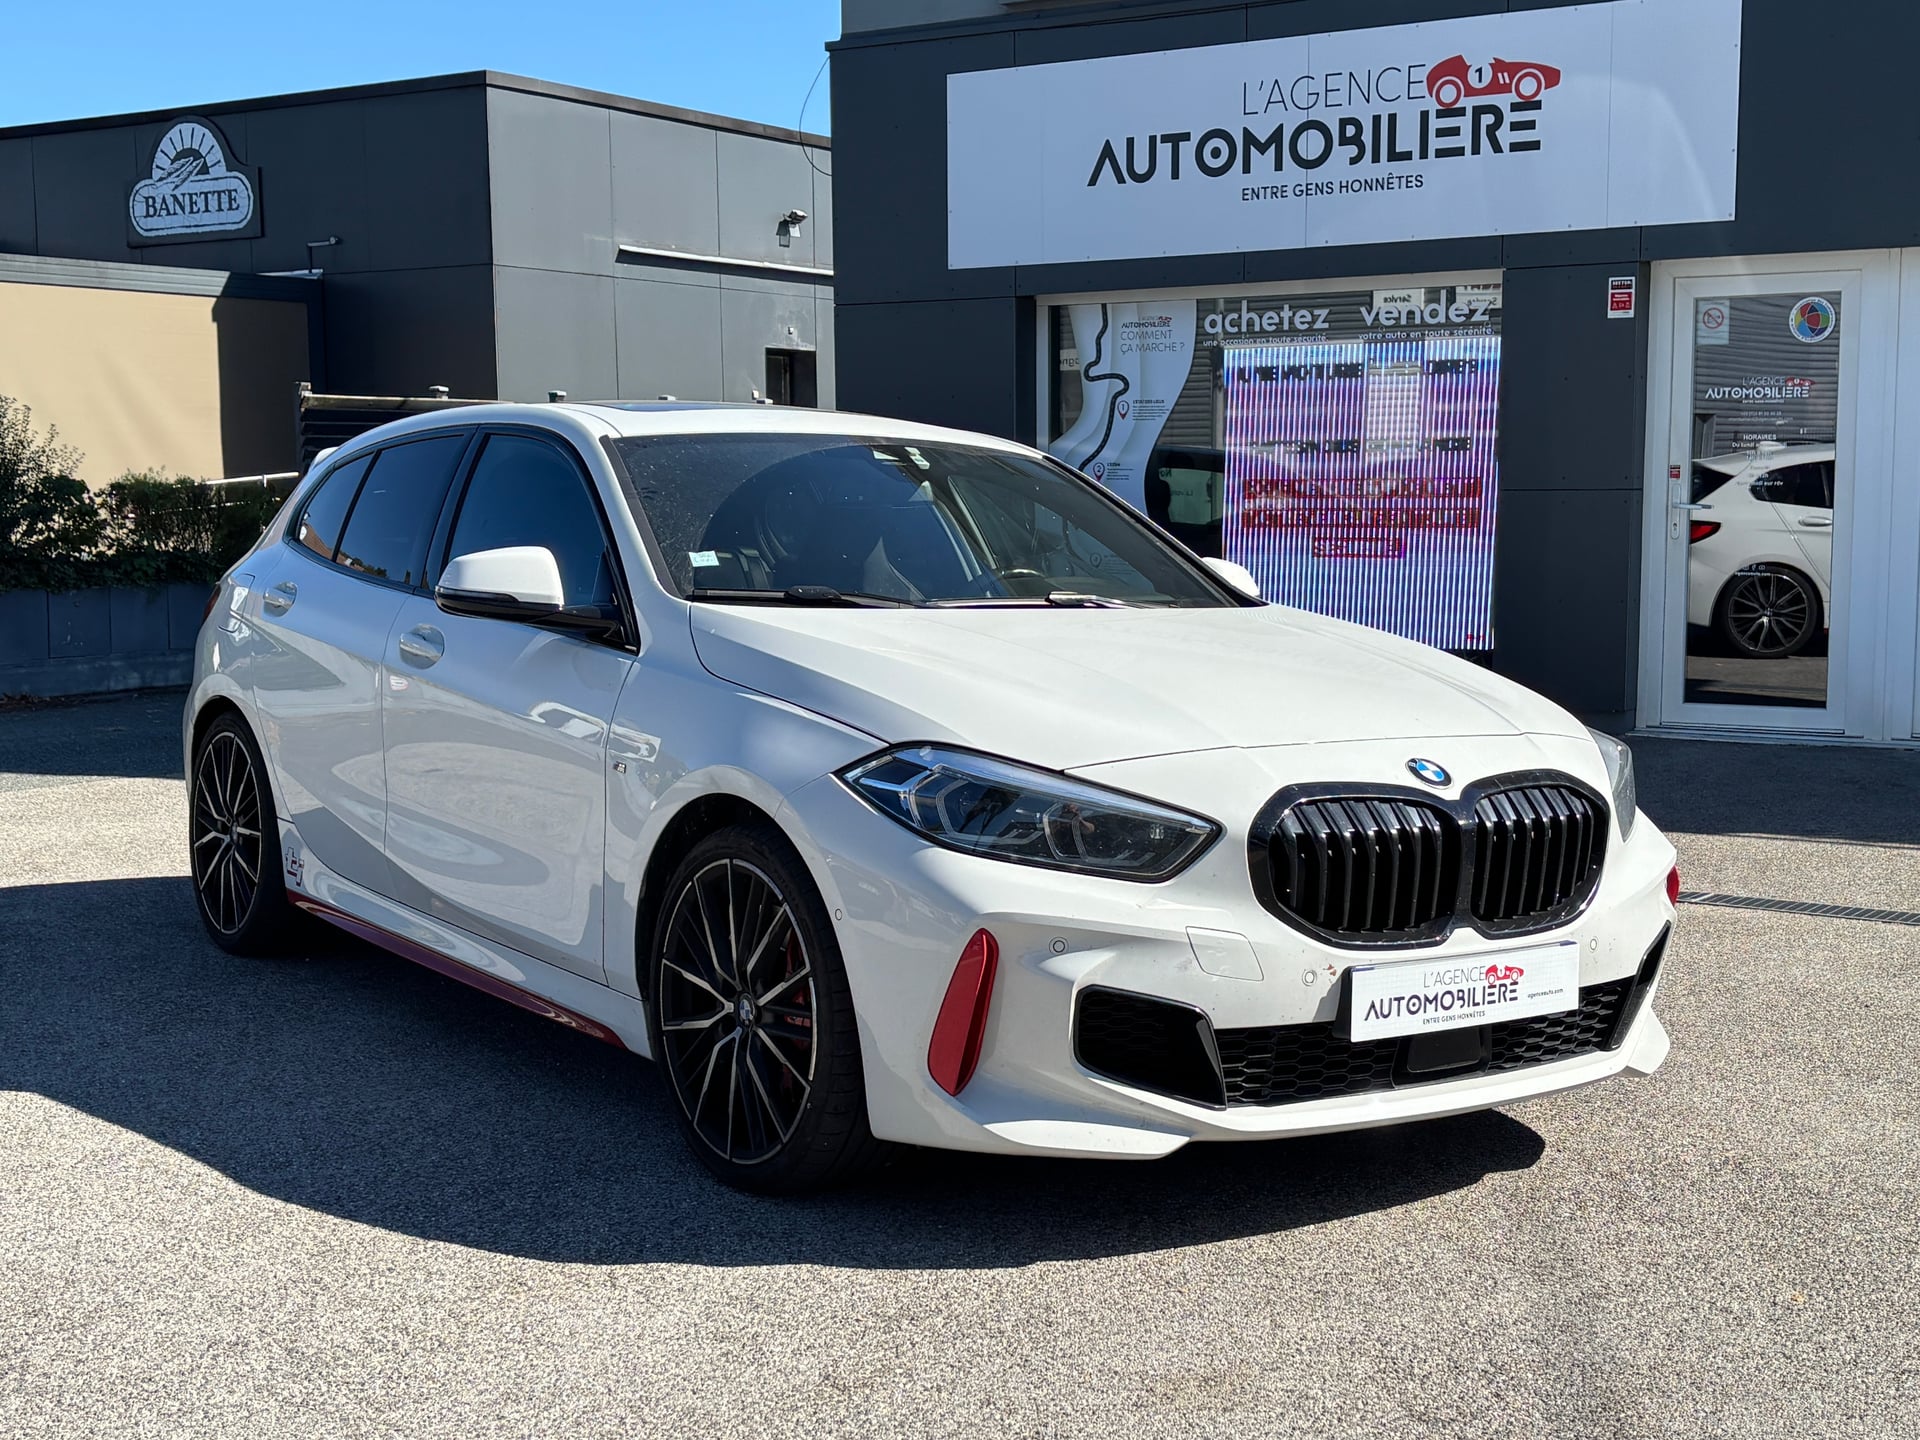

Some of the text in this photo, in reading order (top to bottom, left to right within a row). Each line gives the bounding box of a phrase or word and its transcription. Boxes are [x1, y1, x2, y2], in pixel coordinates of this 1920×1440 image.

[1243, 63, 1427, 116] L'AGENCE
[1241, 172, 1425, 201] ENTRE GENS HONNÊTES
[143, 188, 240, 219] BANETTE
[1203, 299, 1330, 334] achetez
[1359, 289, 1491, 327] vendez
[1120, 329, 1173, 341] COMMENT
[1203, 339, 1218, 347] une
[1220, 335, 1254, 346] occasion
[1269, 335, 1292, 344] toute
[1359, 331, 1383, 340] votre
[1385, 329, 1407, 339] auto
[1410, 330, 1422, 338] en
[1425, 327, 1450, 337] toute
[1120, 344, 1134, 356] ÇA
[1135, 341, 1178, 353] MARCHE
[1742, 376, 1786, 386] L'AGENCE
[1423, 965, 1487, 988] L'AGENCE
[1422, 1015, 1440, 1025] ENTRE
[1441, 1013, 1457, 1023] GENS
